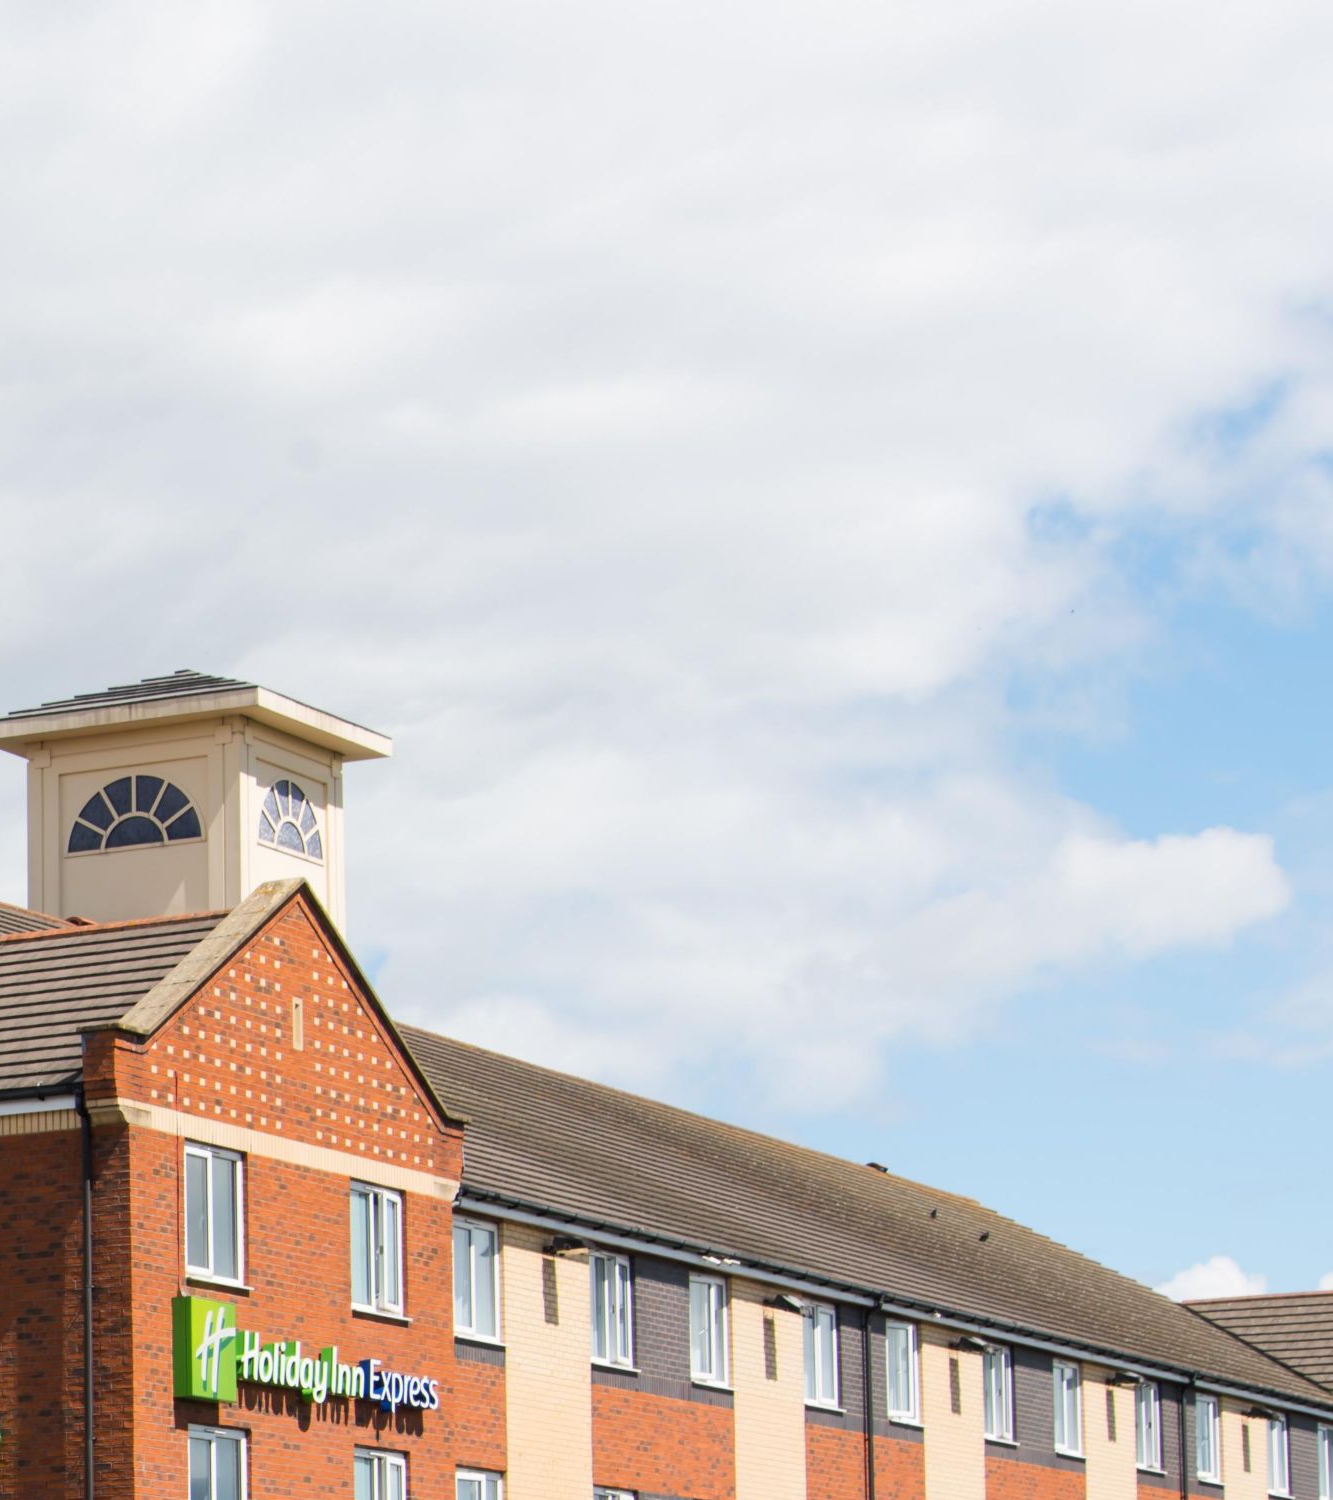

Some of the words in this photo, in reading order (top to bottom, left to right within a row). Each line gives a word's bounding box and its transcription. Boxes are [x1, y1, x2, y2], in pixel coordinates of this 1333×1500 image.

[240, 1329, 329, 1404] Holiday
[331, 1345, 366, 1400] Inn
[369, 1358, 439, 1414] Express
